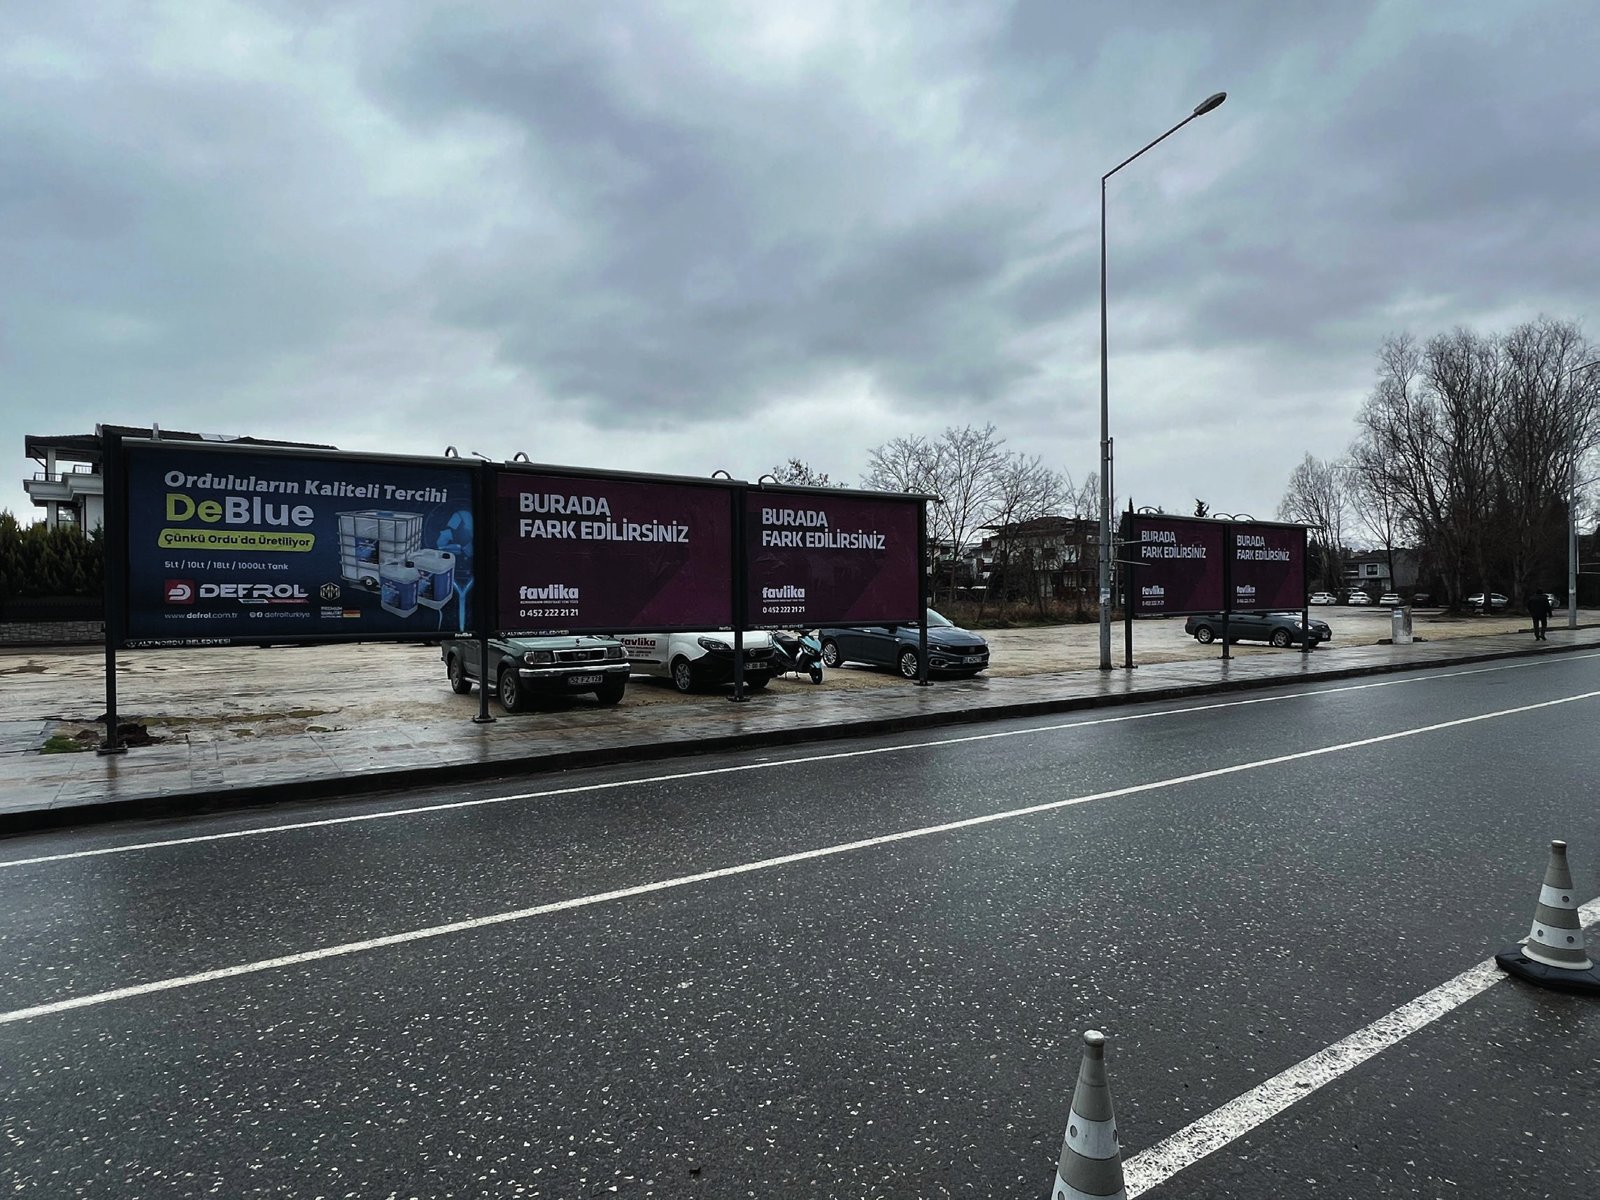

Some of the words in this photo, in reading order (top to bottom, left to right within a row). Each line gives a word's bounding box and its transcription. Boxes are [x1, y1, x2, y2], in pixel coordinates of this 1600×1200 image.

[164, 470, 299, 494] Orduluların
[304, 480, 380, 499] Kaliteli
[384, 485, 448, 503] Tercihi
[166, 493, 315, 527] DeBlue
[519, 492, 611, 517] BURADA
[762, 507, 829, 528] BURADA
[519, 518, 577, 539] FARK
[580, 517, 689, 543] EDİLİRSİNİZ
[1141, 530, 1177, 543] BURADA
[164, 533, 206, 545] Çünkü
[208, 535, 256, 545] Ordu'da
[258, 535, 311, 548] Üretiliyor
[762, 530, 804, 548] FARK
[805, 528, 886, 550] EDİLİRSİNİZ
[1236, 534, 1266, 547] BURADA
[1141, 546, 1163, 558] FARK
[1236, 549, 1255, 560] FARK
[164, 560, 179, 569] 5Lt
[187, 561, 205, 569] 10Lt
[213, 561, 230, 569] 18Lt
[238, 562, 266, 570] 1000Lt
[200, 584, 309, 598] DEFROL
[519, 584, 579, 600] favlika
[762, 585, 806, 599] favlika
[164, 611, 239, 620] www.defrol.com.tr
[520, 609, 526, 618] 0
[527, 609, 543, 617] 452
[544, 608, 559, 617] 222
[560, 608, 569, 617] 21
[570, 608, 579, 617] 21
[762, 606, 768, 614] 0
[620, 637, 656, 647] favlika
